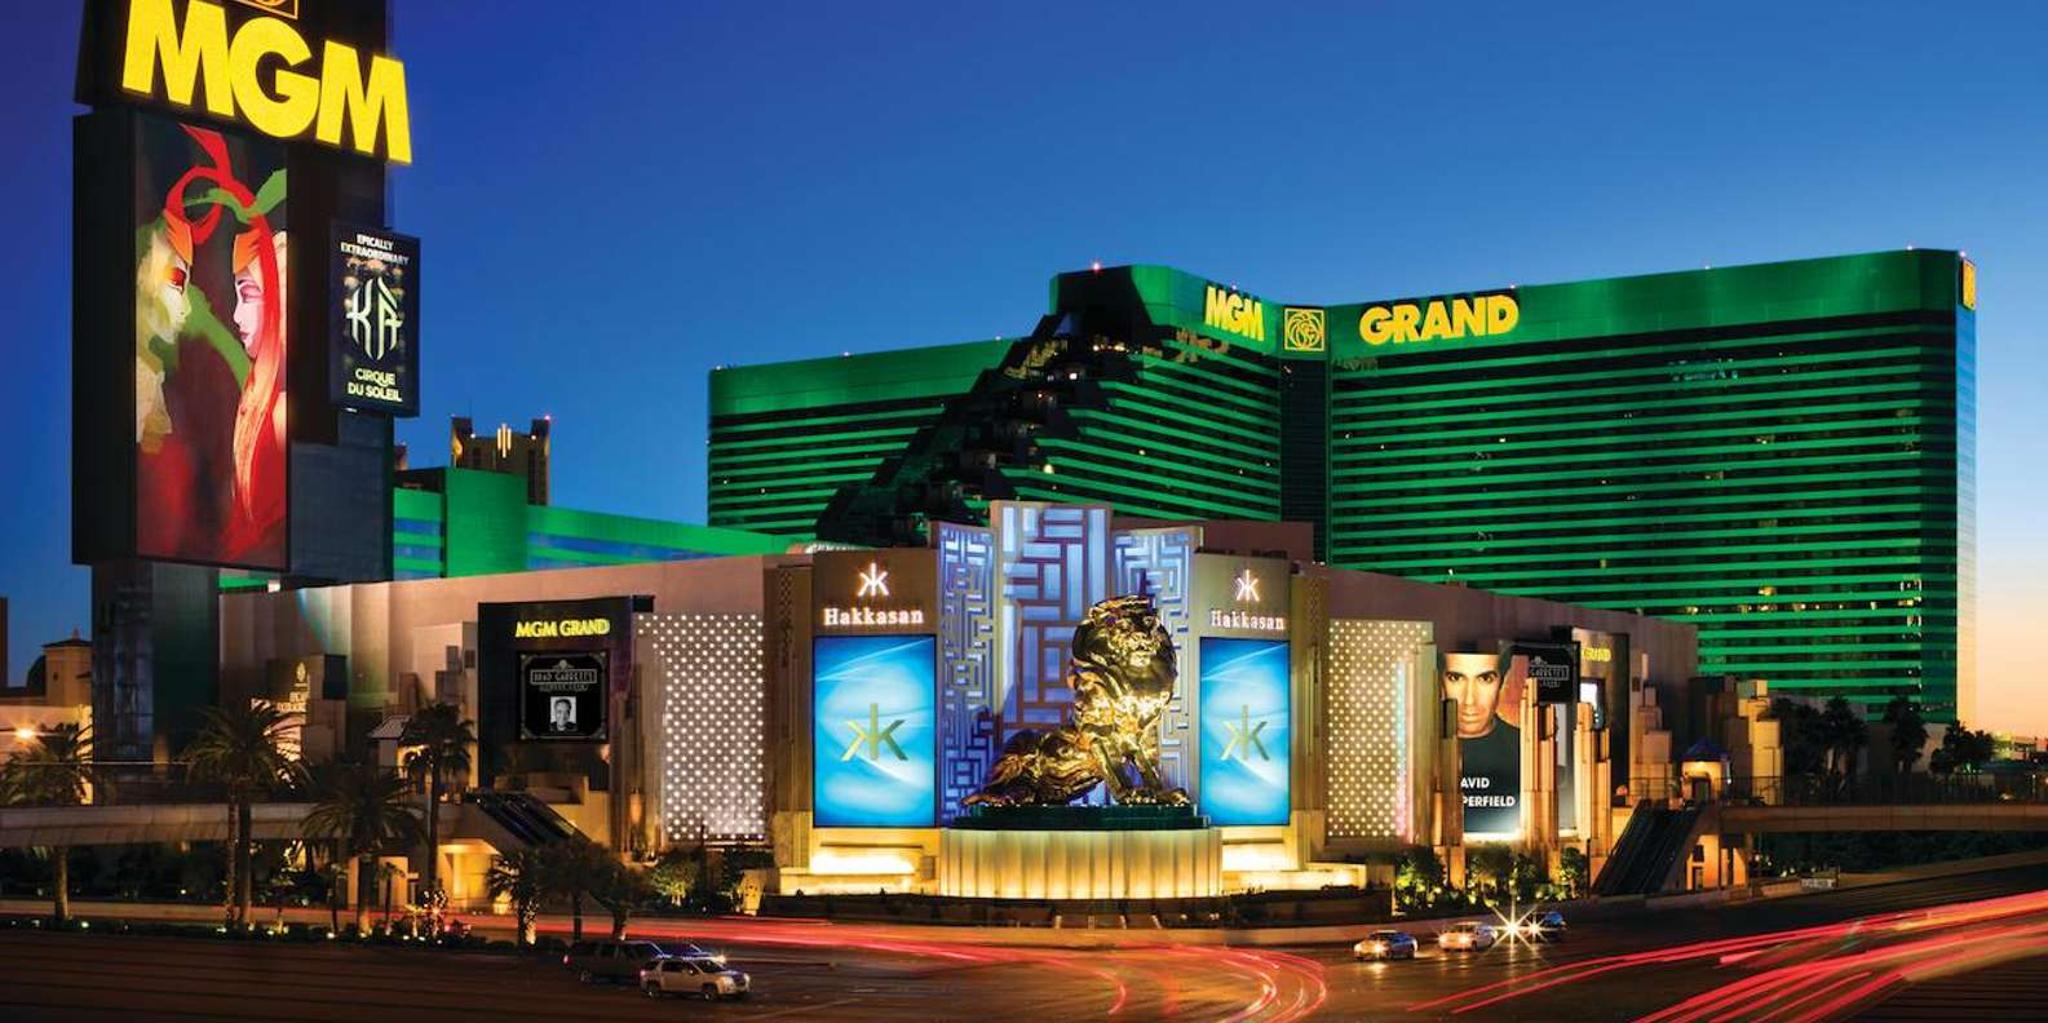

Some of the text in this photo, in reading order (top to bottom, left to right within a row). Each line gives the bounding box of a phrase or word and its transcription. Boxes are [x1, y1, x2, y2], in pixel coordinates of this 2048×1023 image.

[122, 0, 413, 164] MGM
[357, 234, 394, 251] EPICALLY
[340, 242, 410, 265] EXTRAORDINARY
[1205, 286, 1520, 345] MGM GRAND
[355, 368, 396, 386] CIRQUE
[347, 382, 403, 402] DU SOLEIL
[823, 606, 924, 626] Hakkasan
[1210, 609, 1285, 631] Hakkasan
[515, 618, 611, 638] MGM GRAND
[1460, 777, 1491, 789] AVID
[1462, 795, 1516, 807] PERFIELD
